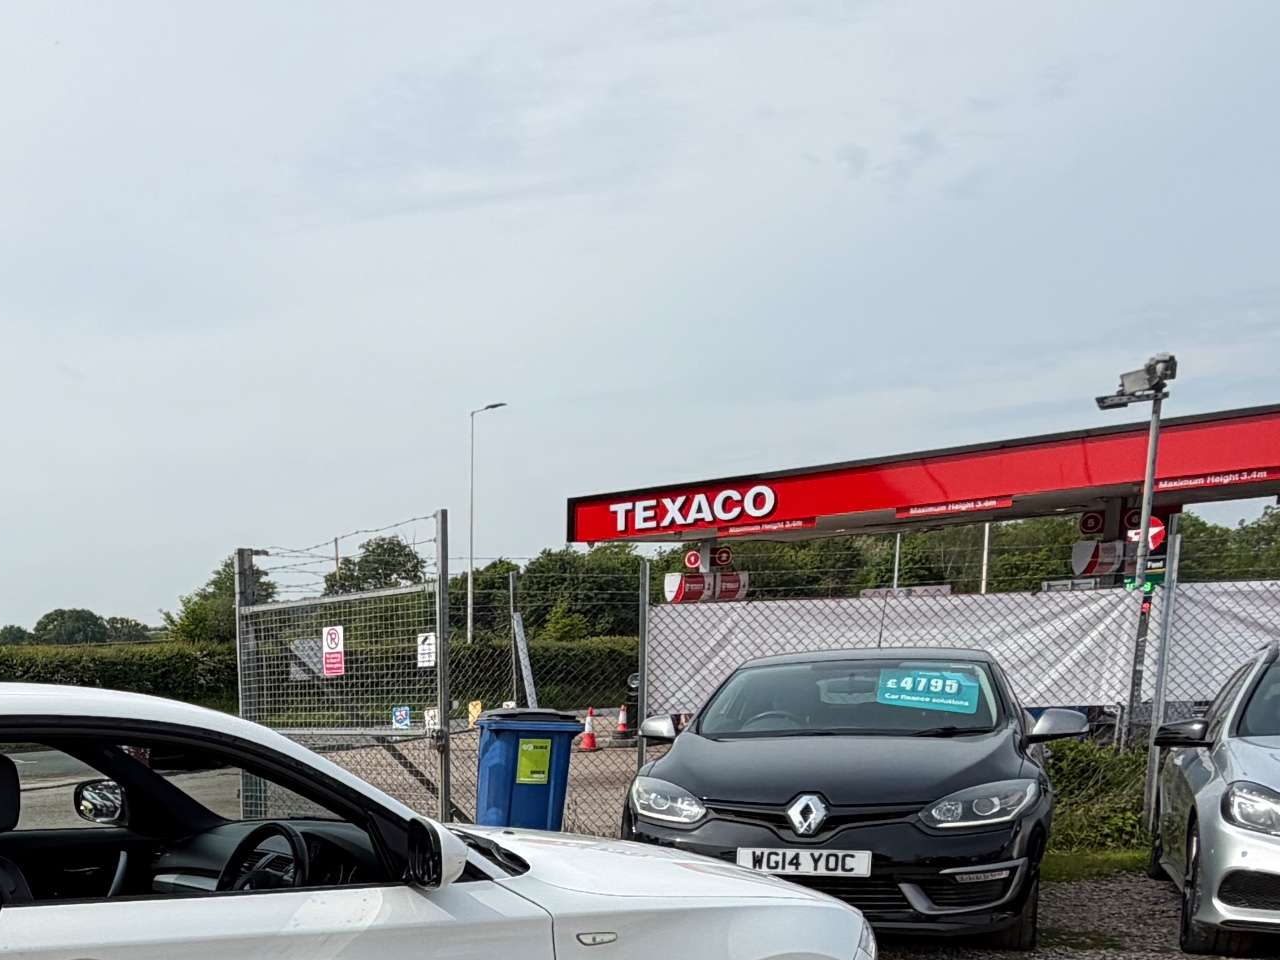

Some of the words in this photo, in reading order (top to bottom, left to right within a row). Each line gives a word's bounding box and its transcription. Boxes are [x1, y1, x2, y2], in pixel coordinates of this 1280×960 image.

[1158, 478, 1205, 489] Maximum
[1207, 473, 1239, 484] Height
[1240, 470, 1268, 481] 3.4m
[609, 485, 776, 532] TEXACO
[885, 677, 959, 694] £4795
[884, 692, 900, 700] Car
[900, 692, 931, 702] finance
[931, 697, 969, 706] solutions
[751, 850, 802, 871] WG14
[812, 852, 856, 873] YOC
